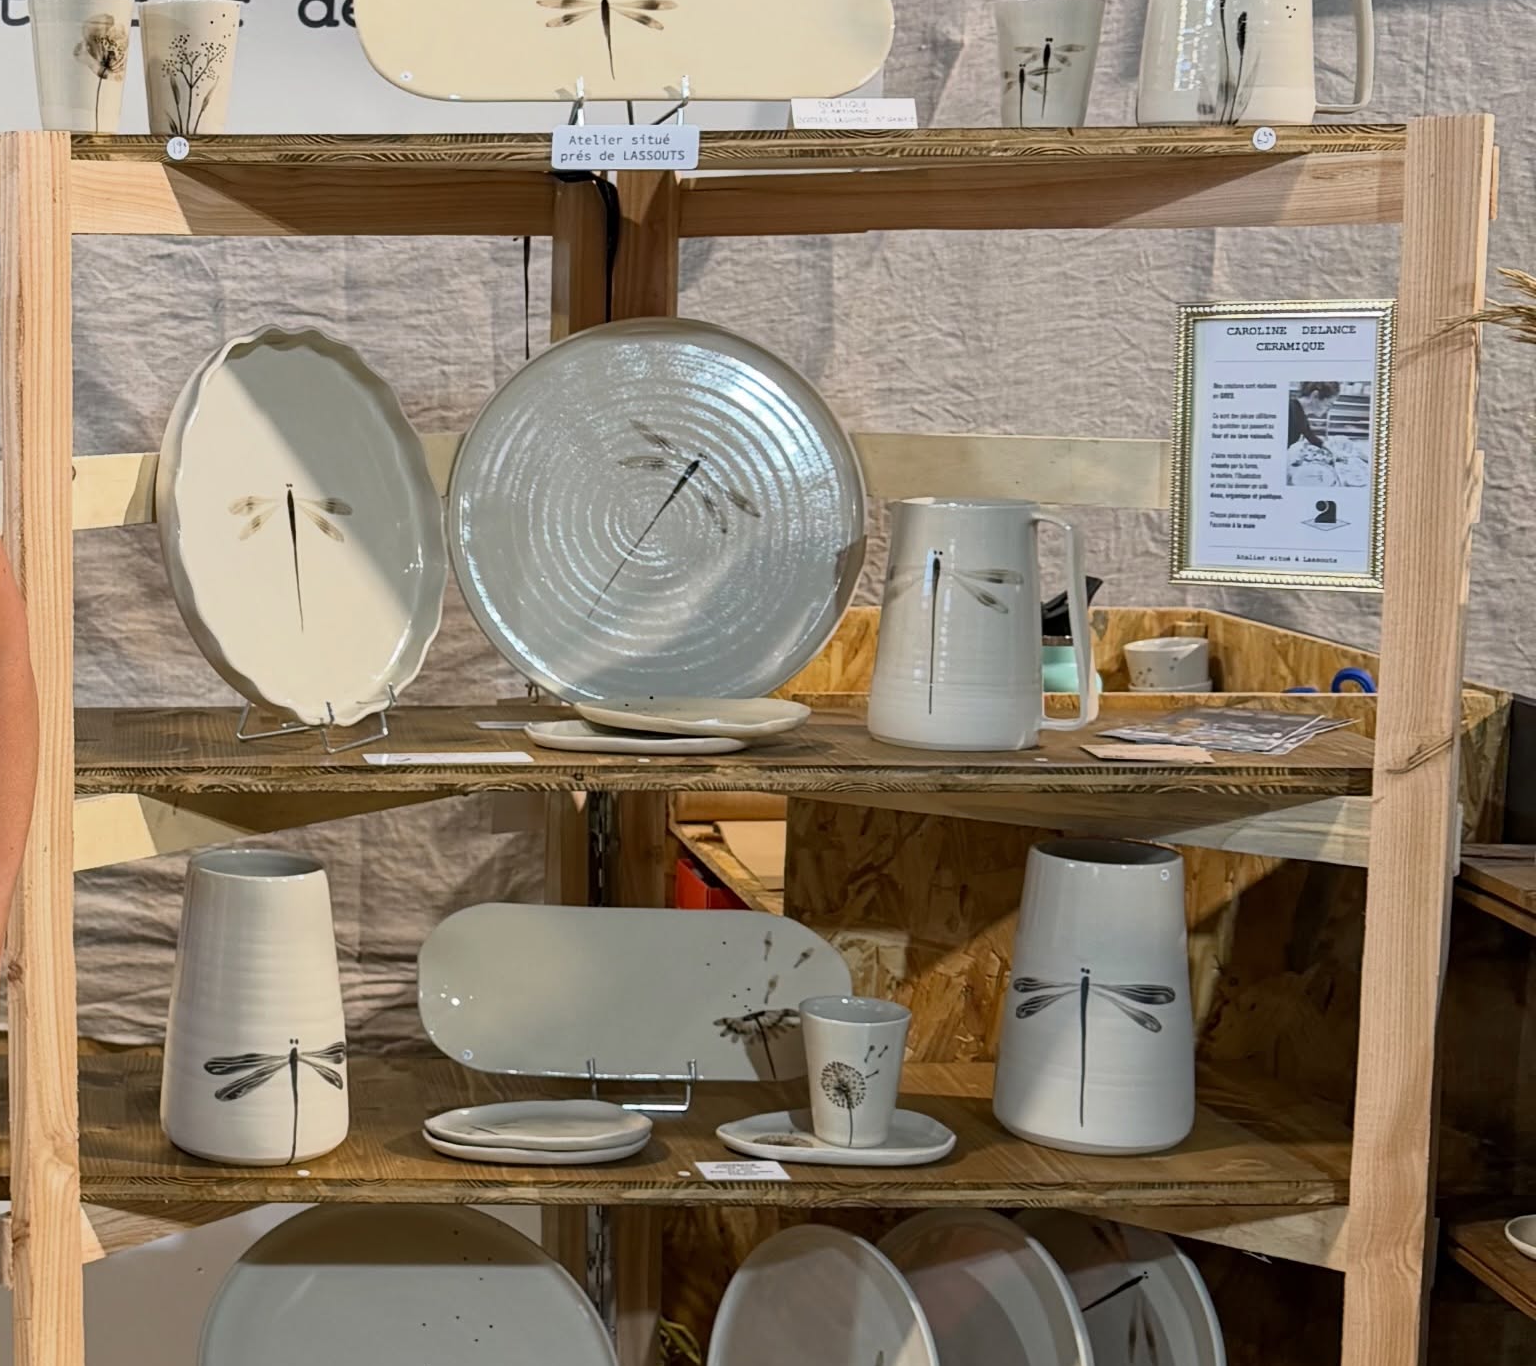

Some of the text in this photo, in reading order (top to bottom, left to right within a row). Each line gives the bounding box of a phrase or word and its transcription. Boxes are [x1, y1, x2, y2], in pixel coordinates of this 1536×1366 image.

[569, 133, 670, 145] Atelier situé
[599, 150, 615, 161] de
[623, 150, 685, 161] LASSOUTS
[1226, 325, 1357, 336] CAROLINE DELANCE
[1255, 342, 1326, 352] CERAMIQUE
